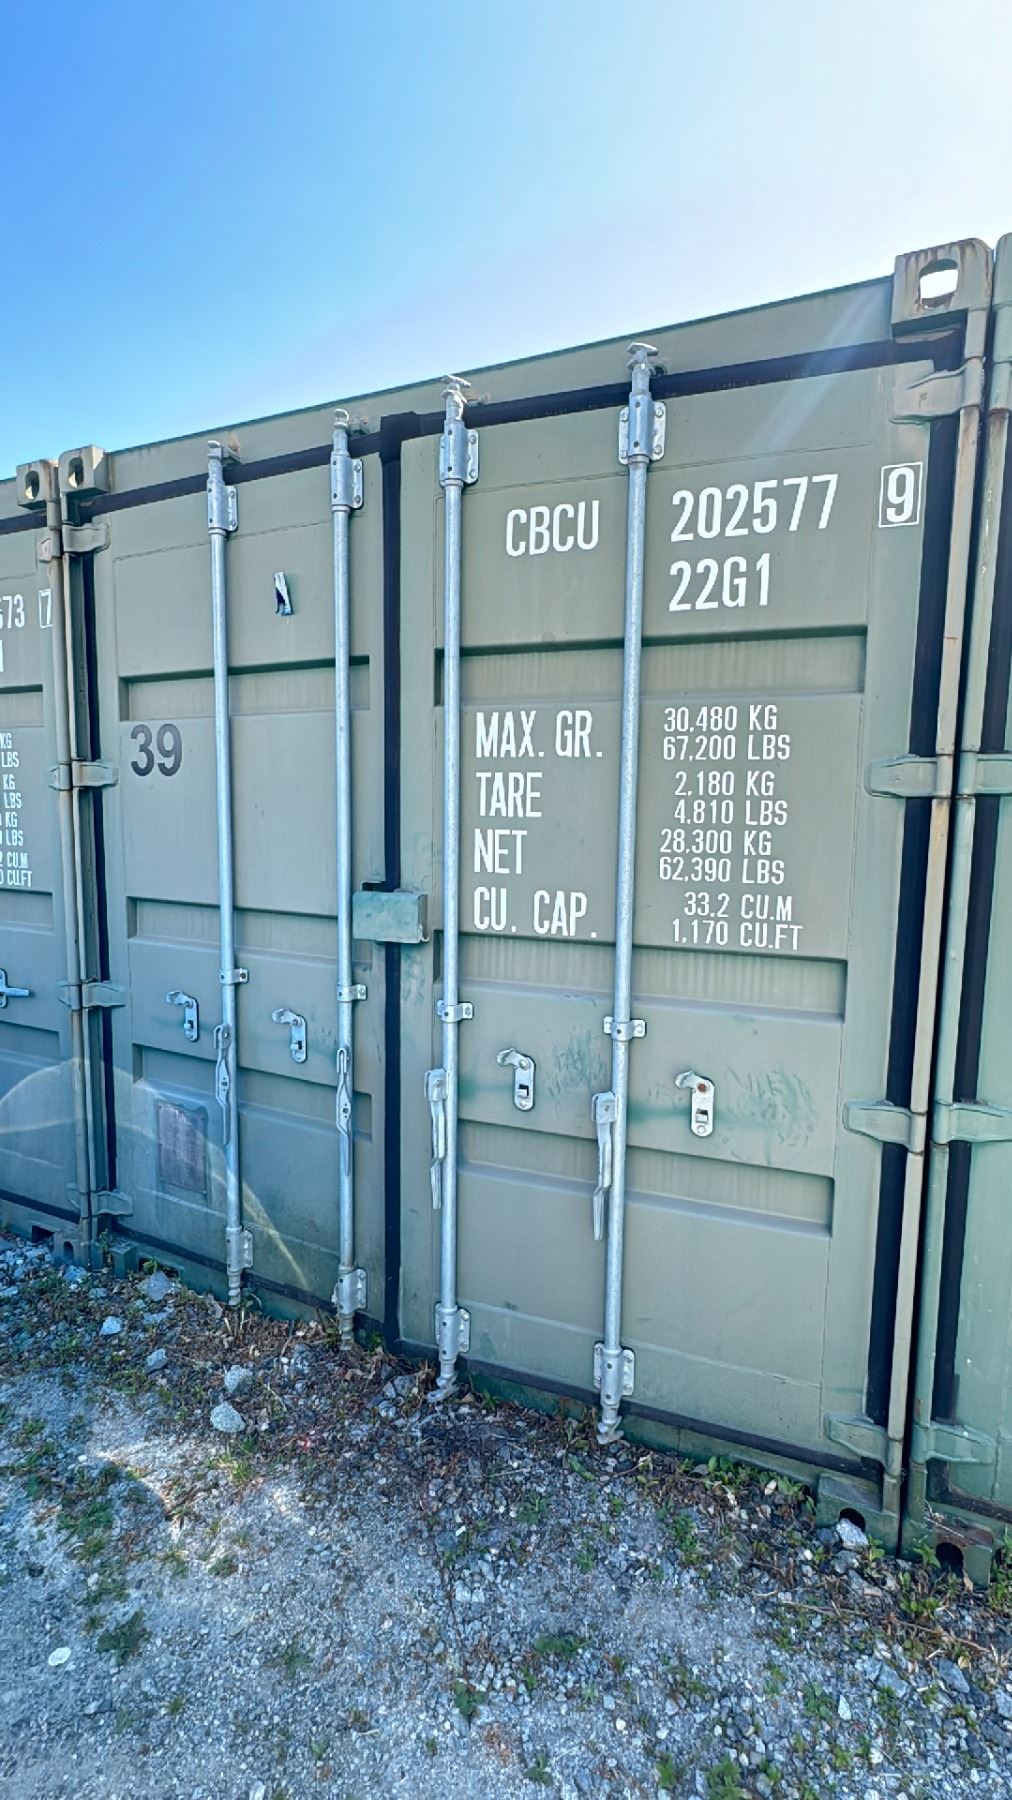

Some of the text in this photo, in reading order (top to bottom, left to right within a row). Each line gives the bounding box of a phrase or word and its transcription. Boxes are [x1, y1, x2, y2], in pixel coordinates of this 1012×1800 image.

[505, 466, 917, 556] CBCU 202577 9
[668, 553, 771, 612] 22G1
[40, 590, 51, 625] 7
[749, 704, 778, 731] KG
[475, 710, 603, 758] MAX. GR.
[747, 734, 790, 760] LBS
[1, 751, 20, 768] LBS
[130, 723, 182, 777] 39
[2, 773, 16, 790] KG
[475, 771, 543, 818] TARE
[746, 770, 775, 796] KG
[3, 792, 22, 809] LBS
[745, 799, 788, 826] LBS
[5, 811, 18, 828] KG
[5, 829, 24, 847] LBS
[473, 828, 528, 875] NET
[743, 830, 772, 856] KG
[741, 858, 785, 885] LBS
[473, 886, 597, 939] CU. CAP.
[683, 891, 793, 922] 33.2 CU.M
[740, 921, 803, 951] CU.FT
